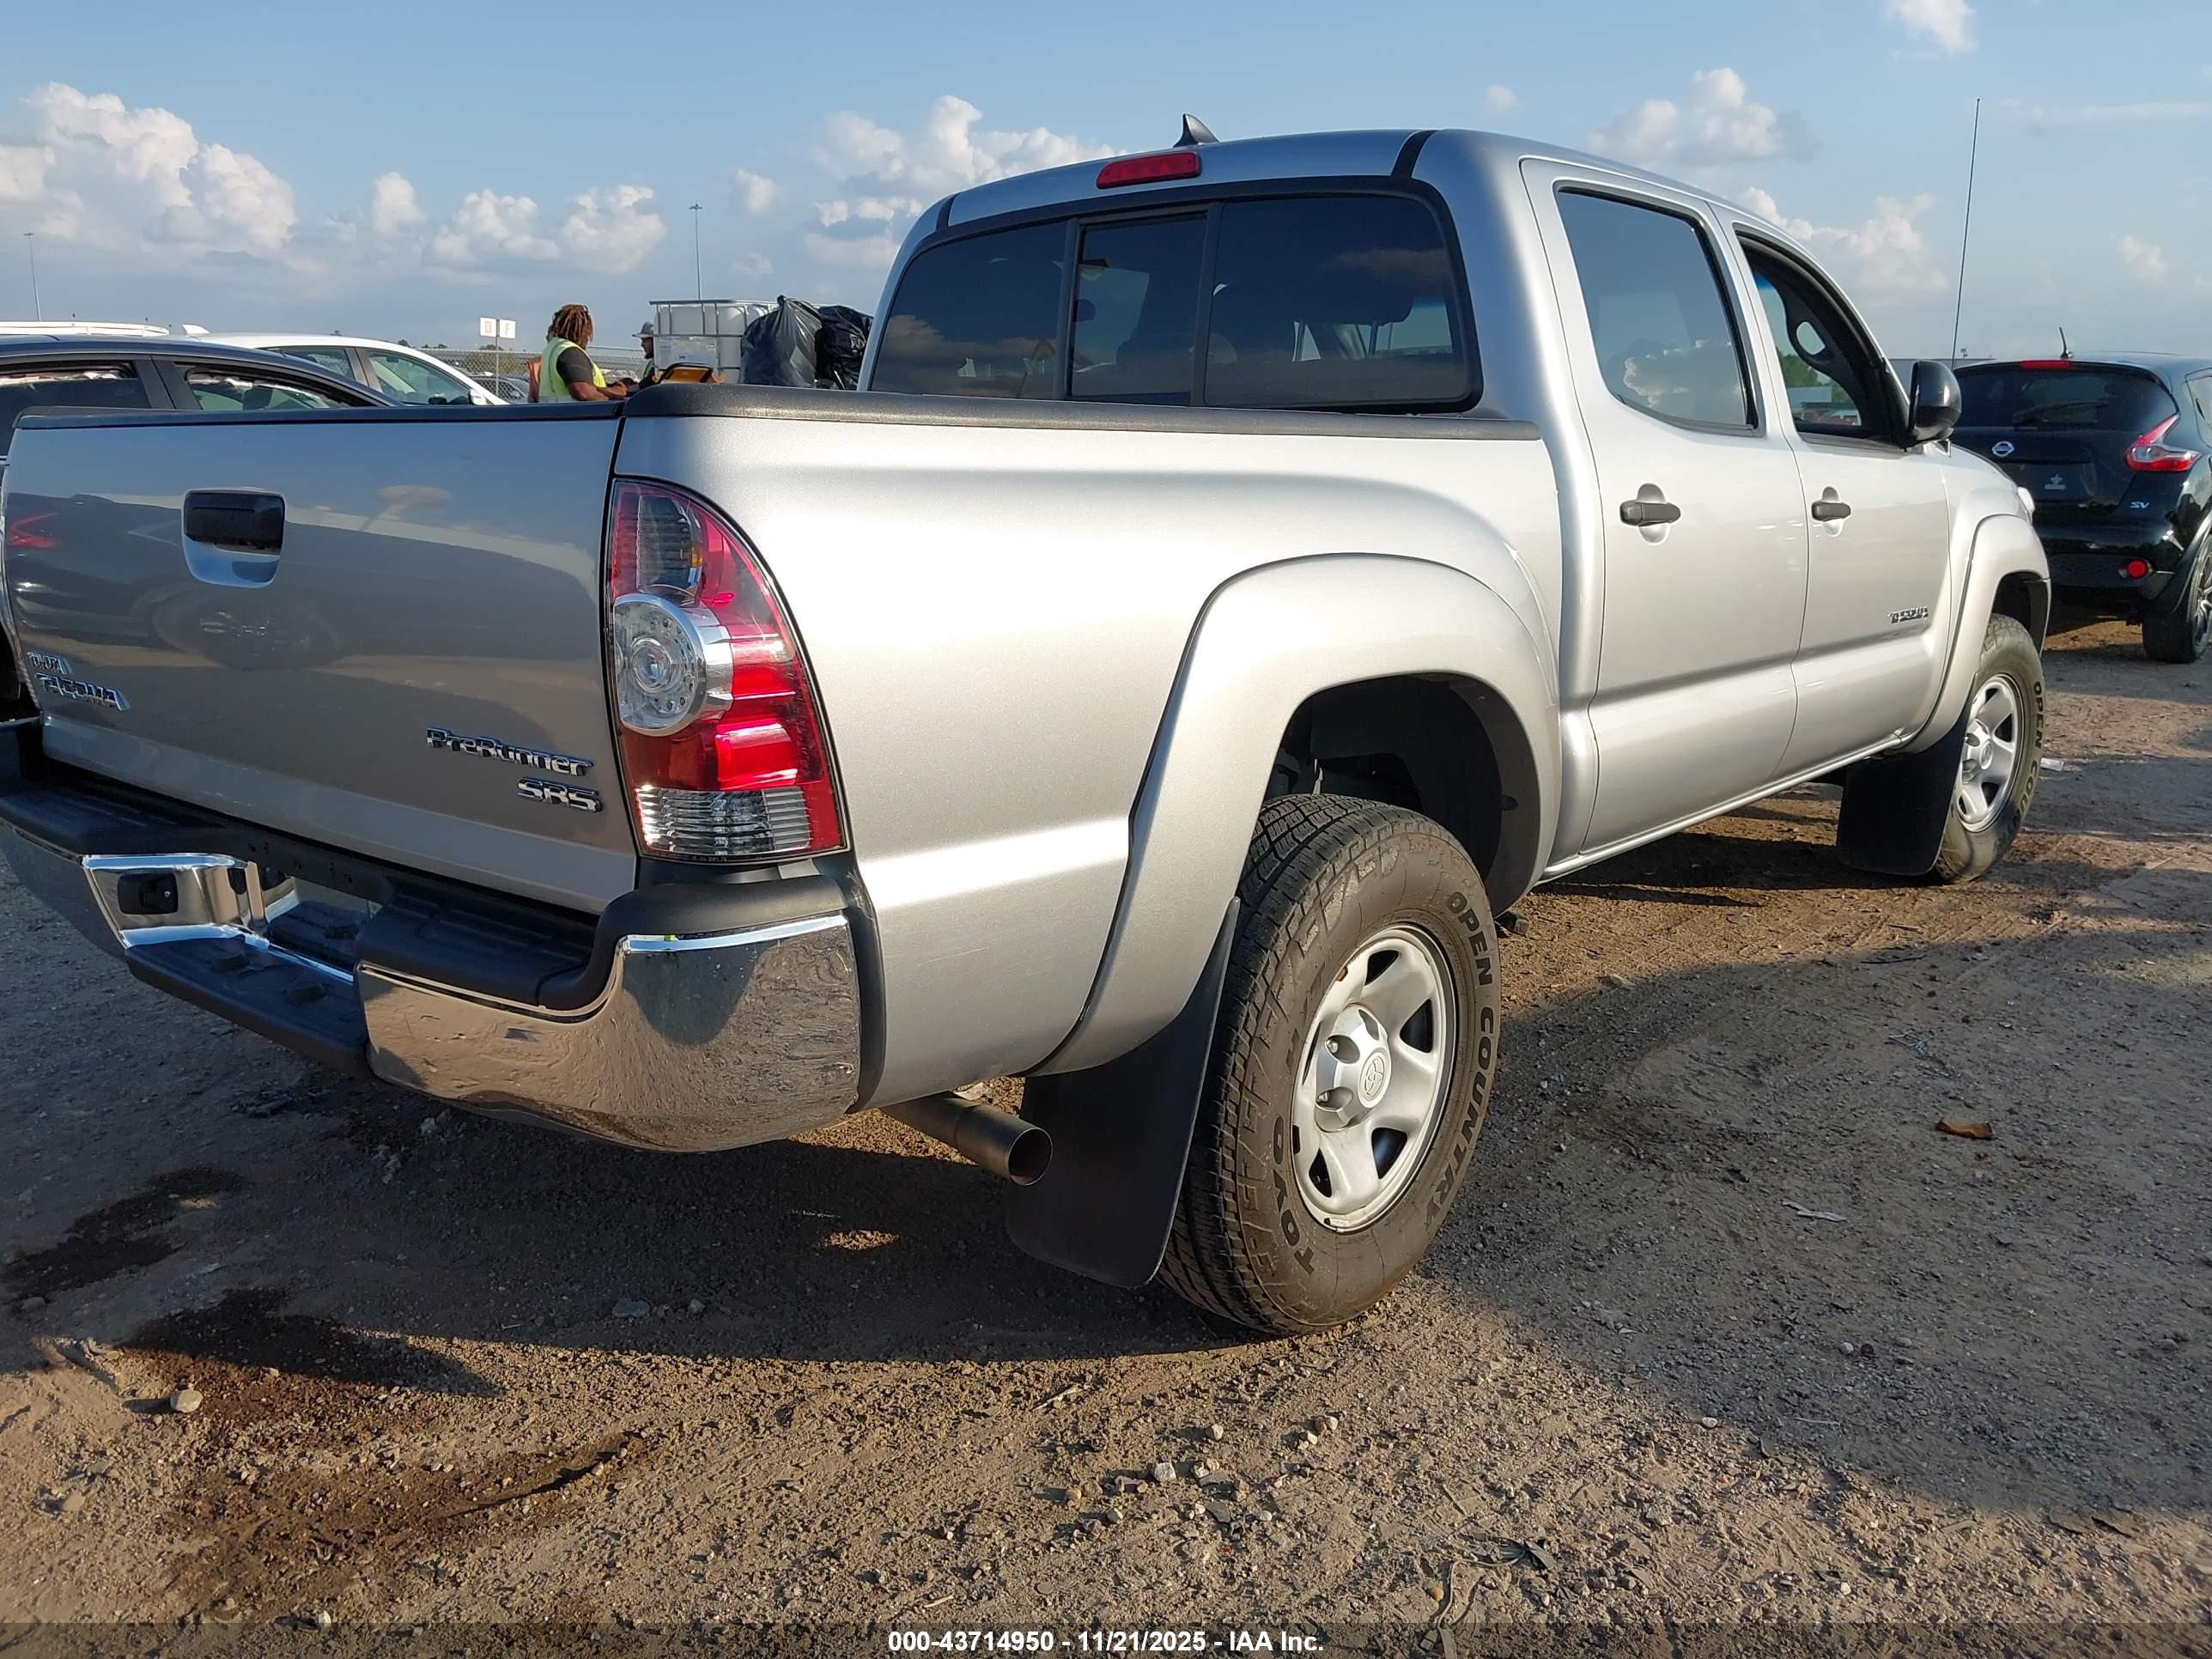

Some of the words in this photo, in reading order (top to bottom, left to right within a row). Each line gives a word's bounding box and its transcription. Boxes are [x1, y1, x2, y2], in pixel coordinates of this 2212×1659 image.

[427, 727, 593, 776] PreRunner
[2033, 681, 2044, 749] OPEN
[517, 776, 603, 813] SR5
[1447, 891, 1493, 986] OPEN
[1425, 1006, 1494, 1231] COUNTRY
[1273, 1115, 1316, 1272] TOYO
